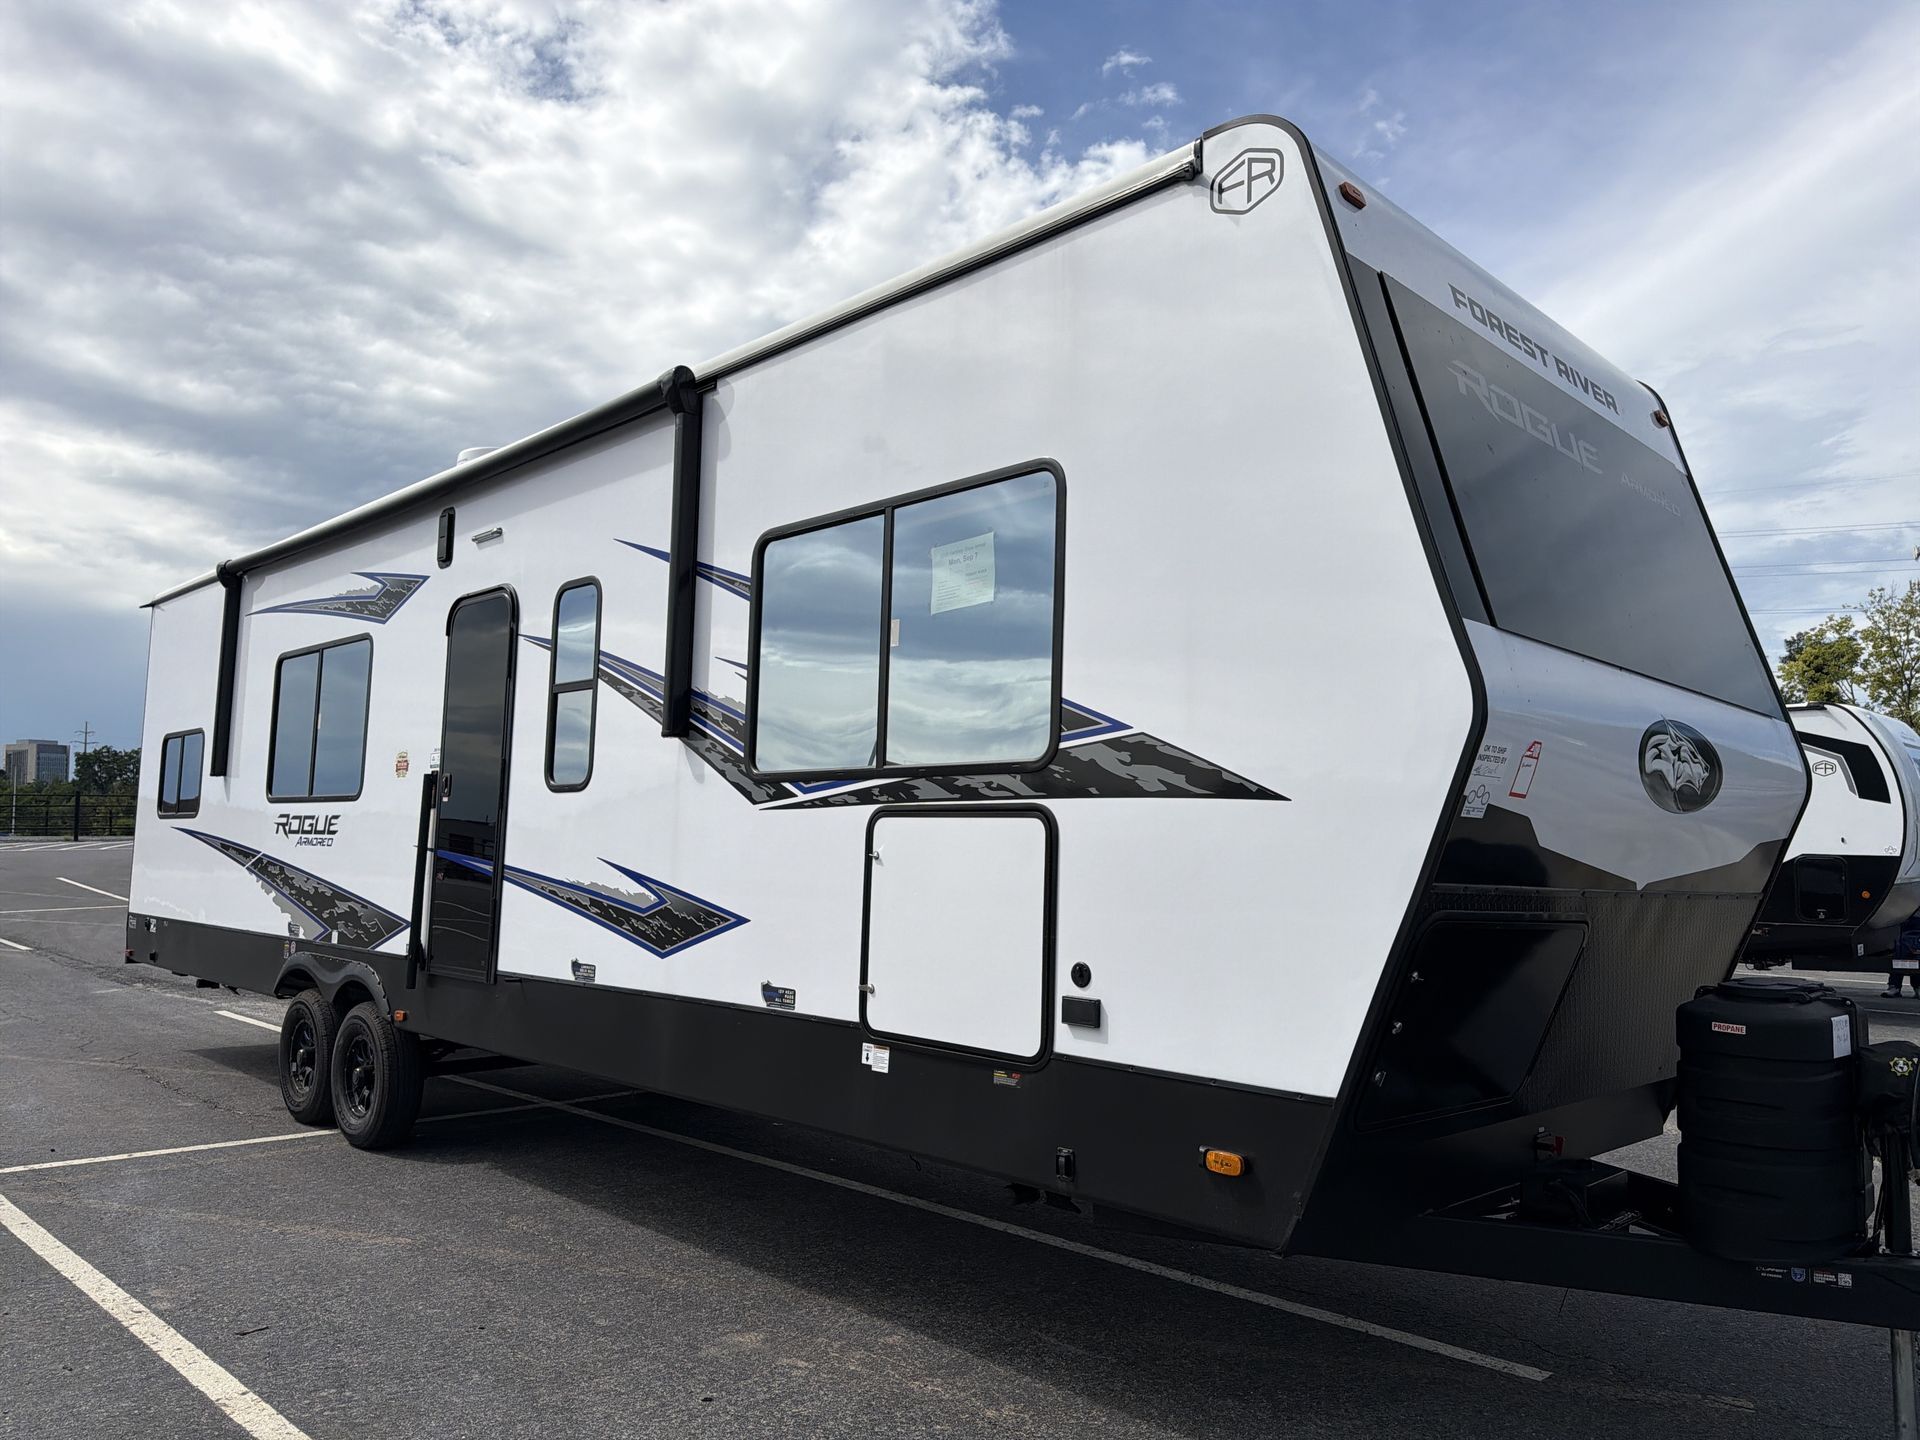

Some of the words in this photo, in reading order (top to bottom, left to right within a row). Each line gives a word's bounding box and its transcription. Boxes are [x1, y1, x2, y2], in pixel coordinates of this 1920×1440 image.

[1448, 283, 1549, 368] FOREST
[1552, 355, 1620, 416] RIVER
[1448, 360, 1603, 475] ROGUE
[274, 814, 341, 839] ROGUE
[295, 836, 334, 847] ARMORED
[1713, 1023, 1745, 1034] PROPANE
